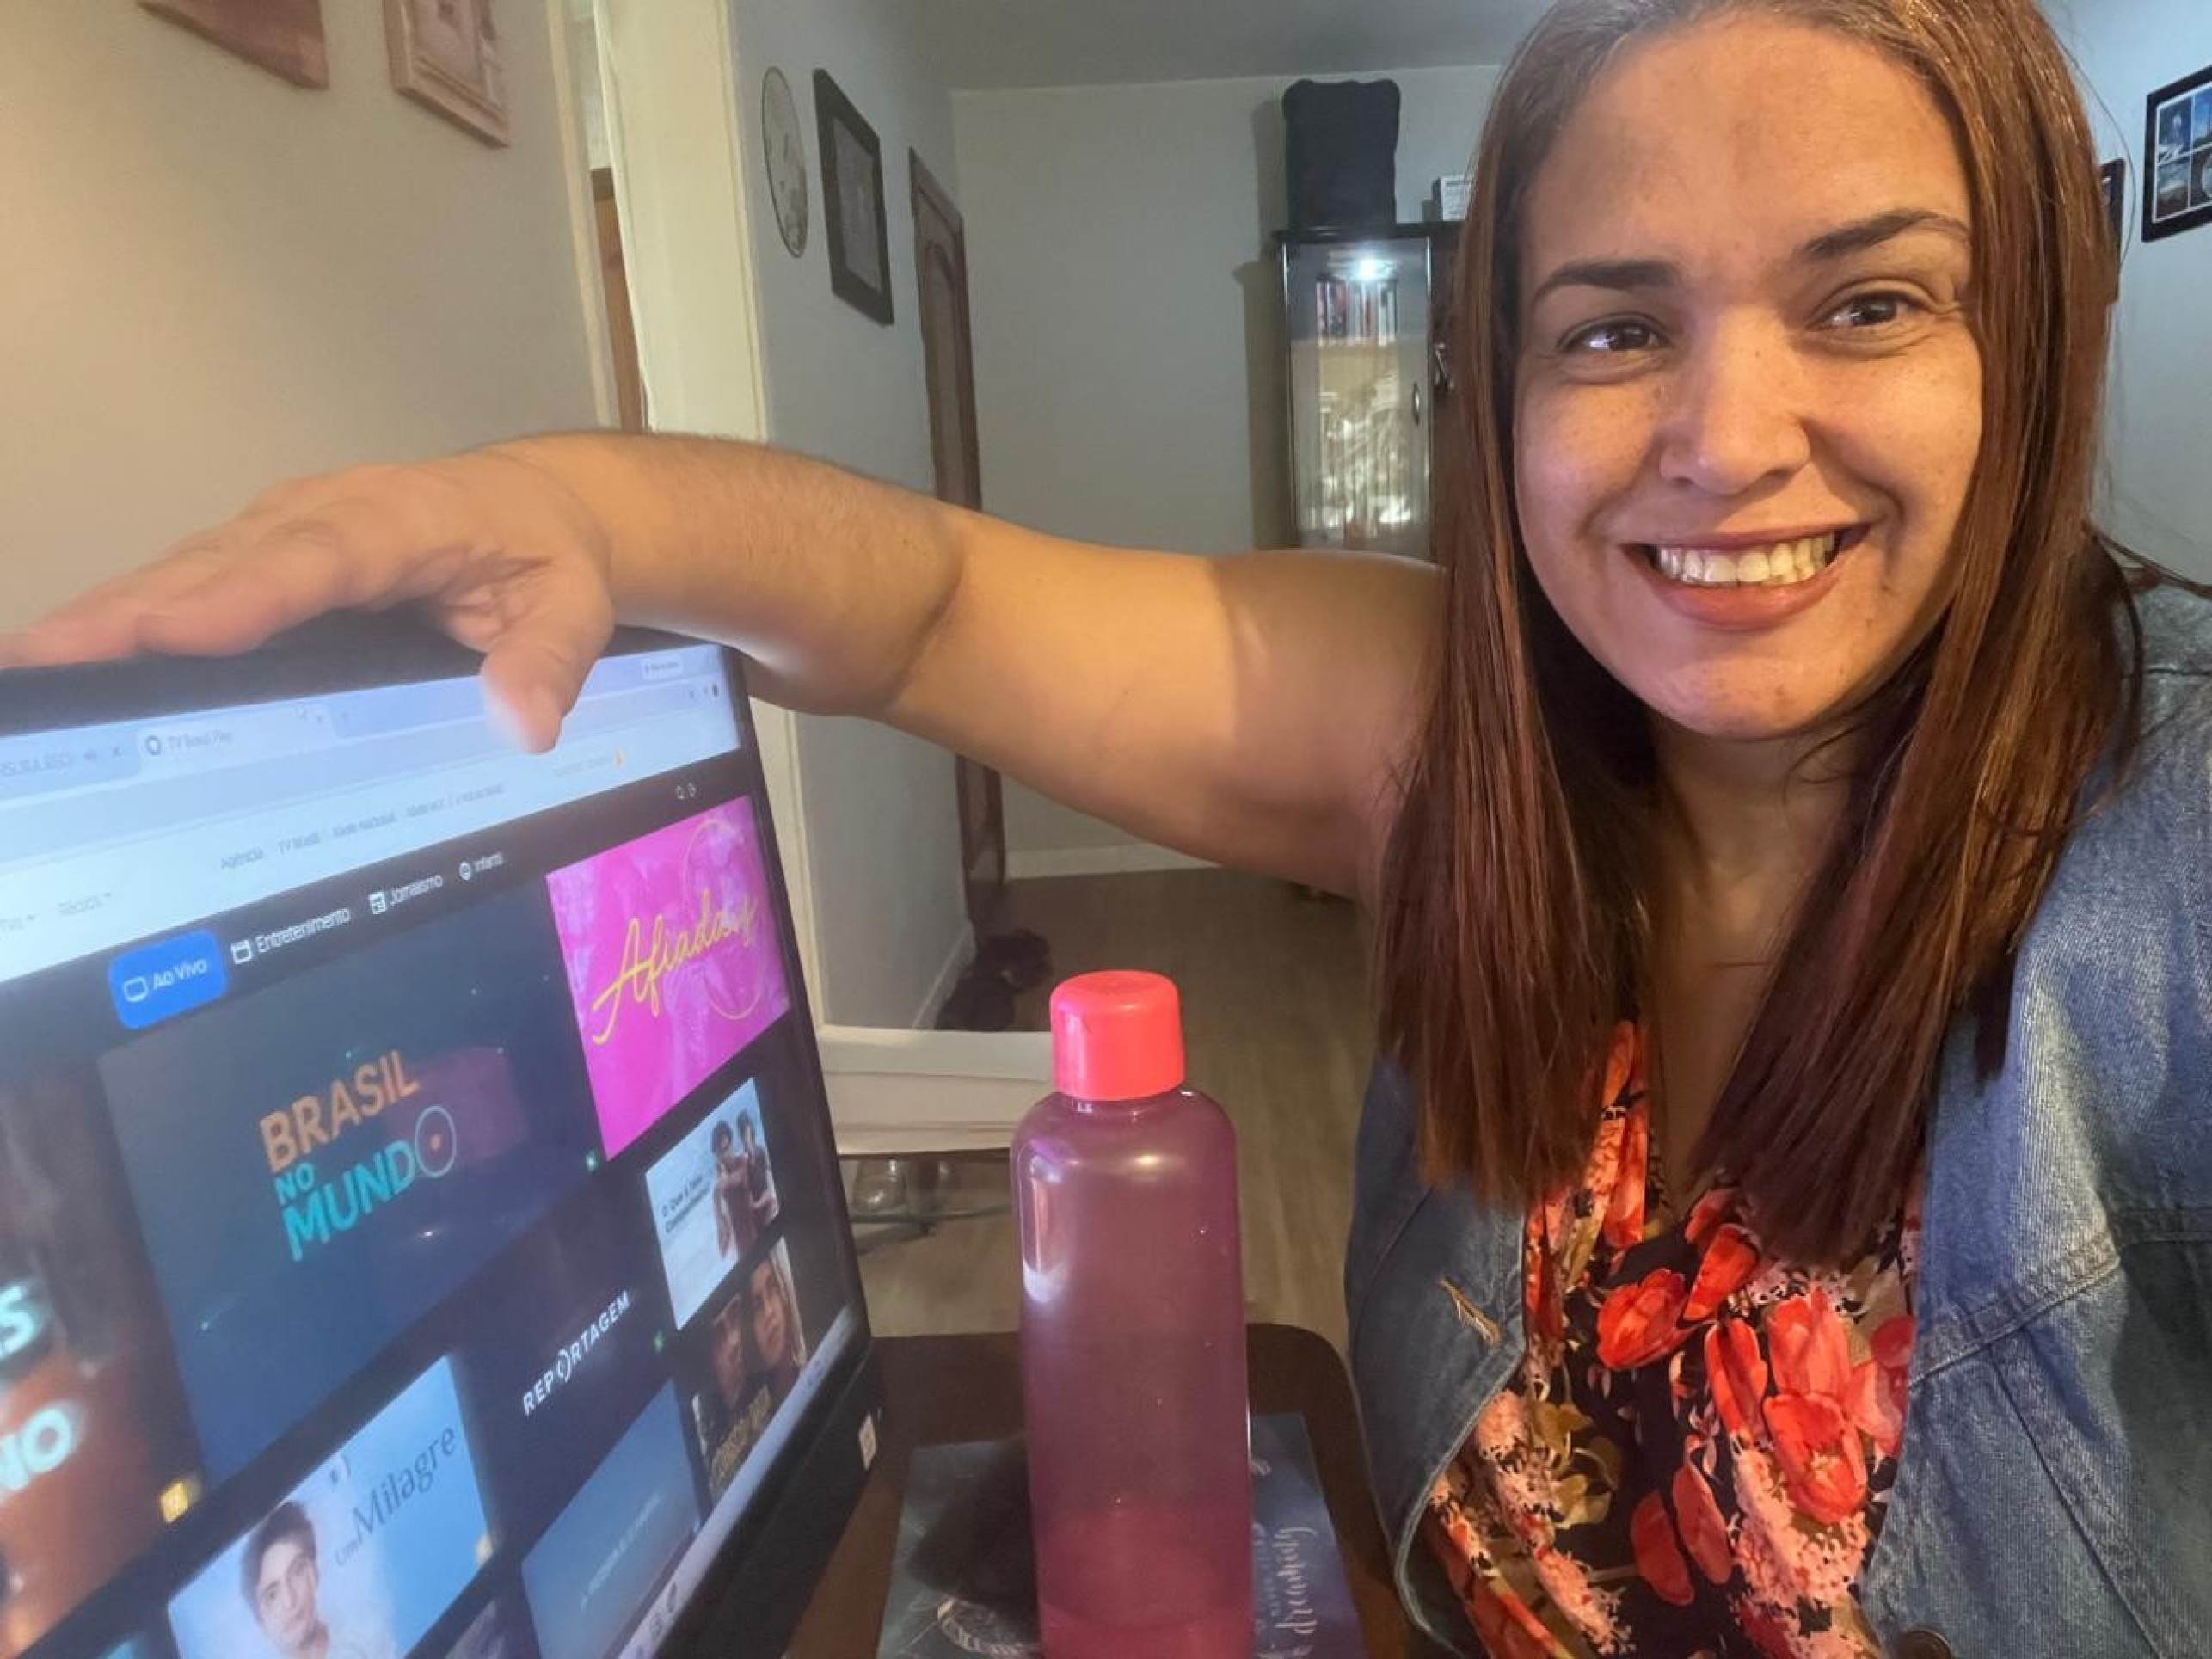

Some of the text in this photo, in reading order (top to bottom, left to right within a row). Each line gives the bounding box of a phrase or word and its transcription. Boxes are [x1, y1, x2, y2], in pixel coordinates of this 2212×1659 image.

[153, 958, 208, 990] Ao Vivo
[256, 908, 352, 953] Entretenimento
[260, 1050, 420, 1172] BRASIL
[275, 1162, 315, 1205] NO
[282, 1105, 457, 1262] MUNDO
[523, 1290, 630, 1417] REPORTAGEM
[353, 1426, 456, 1544] Milagre
